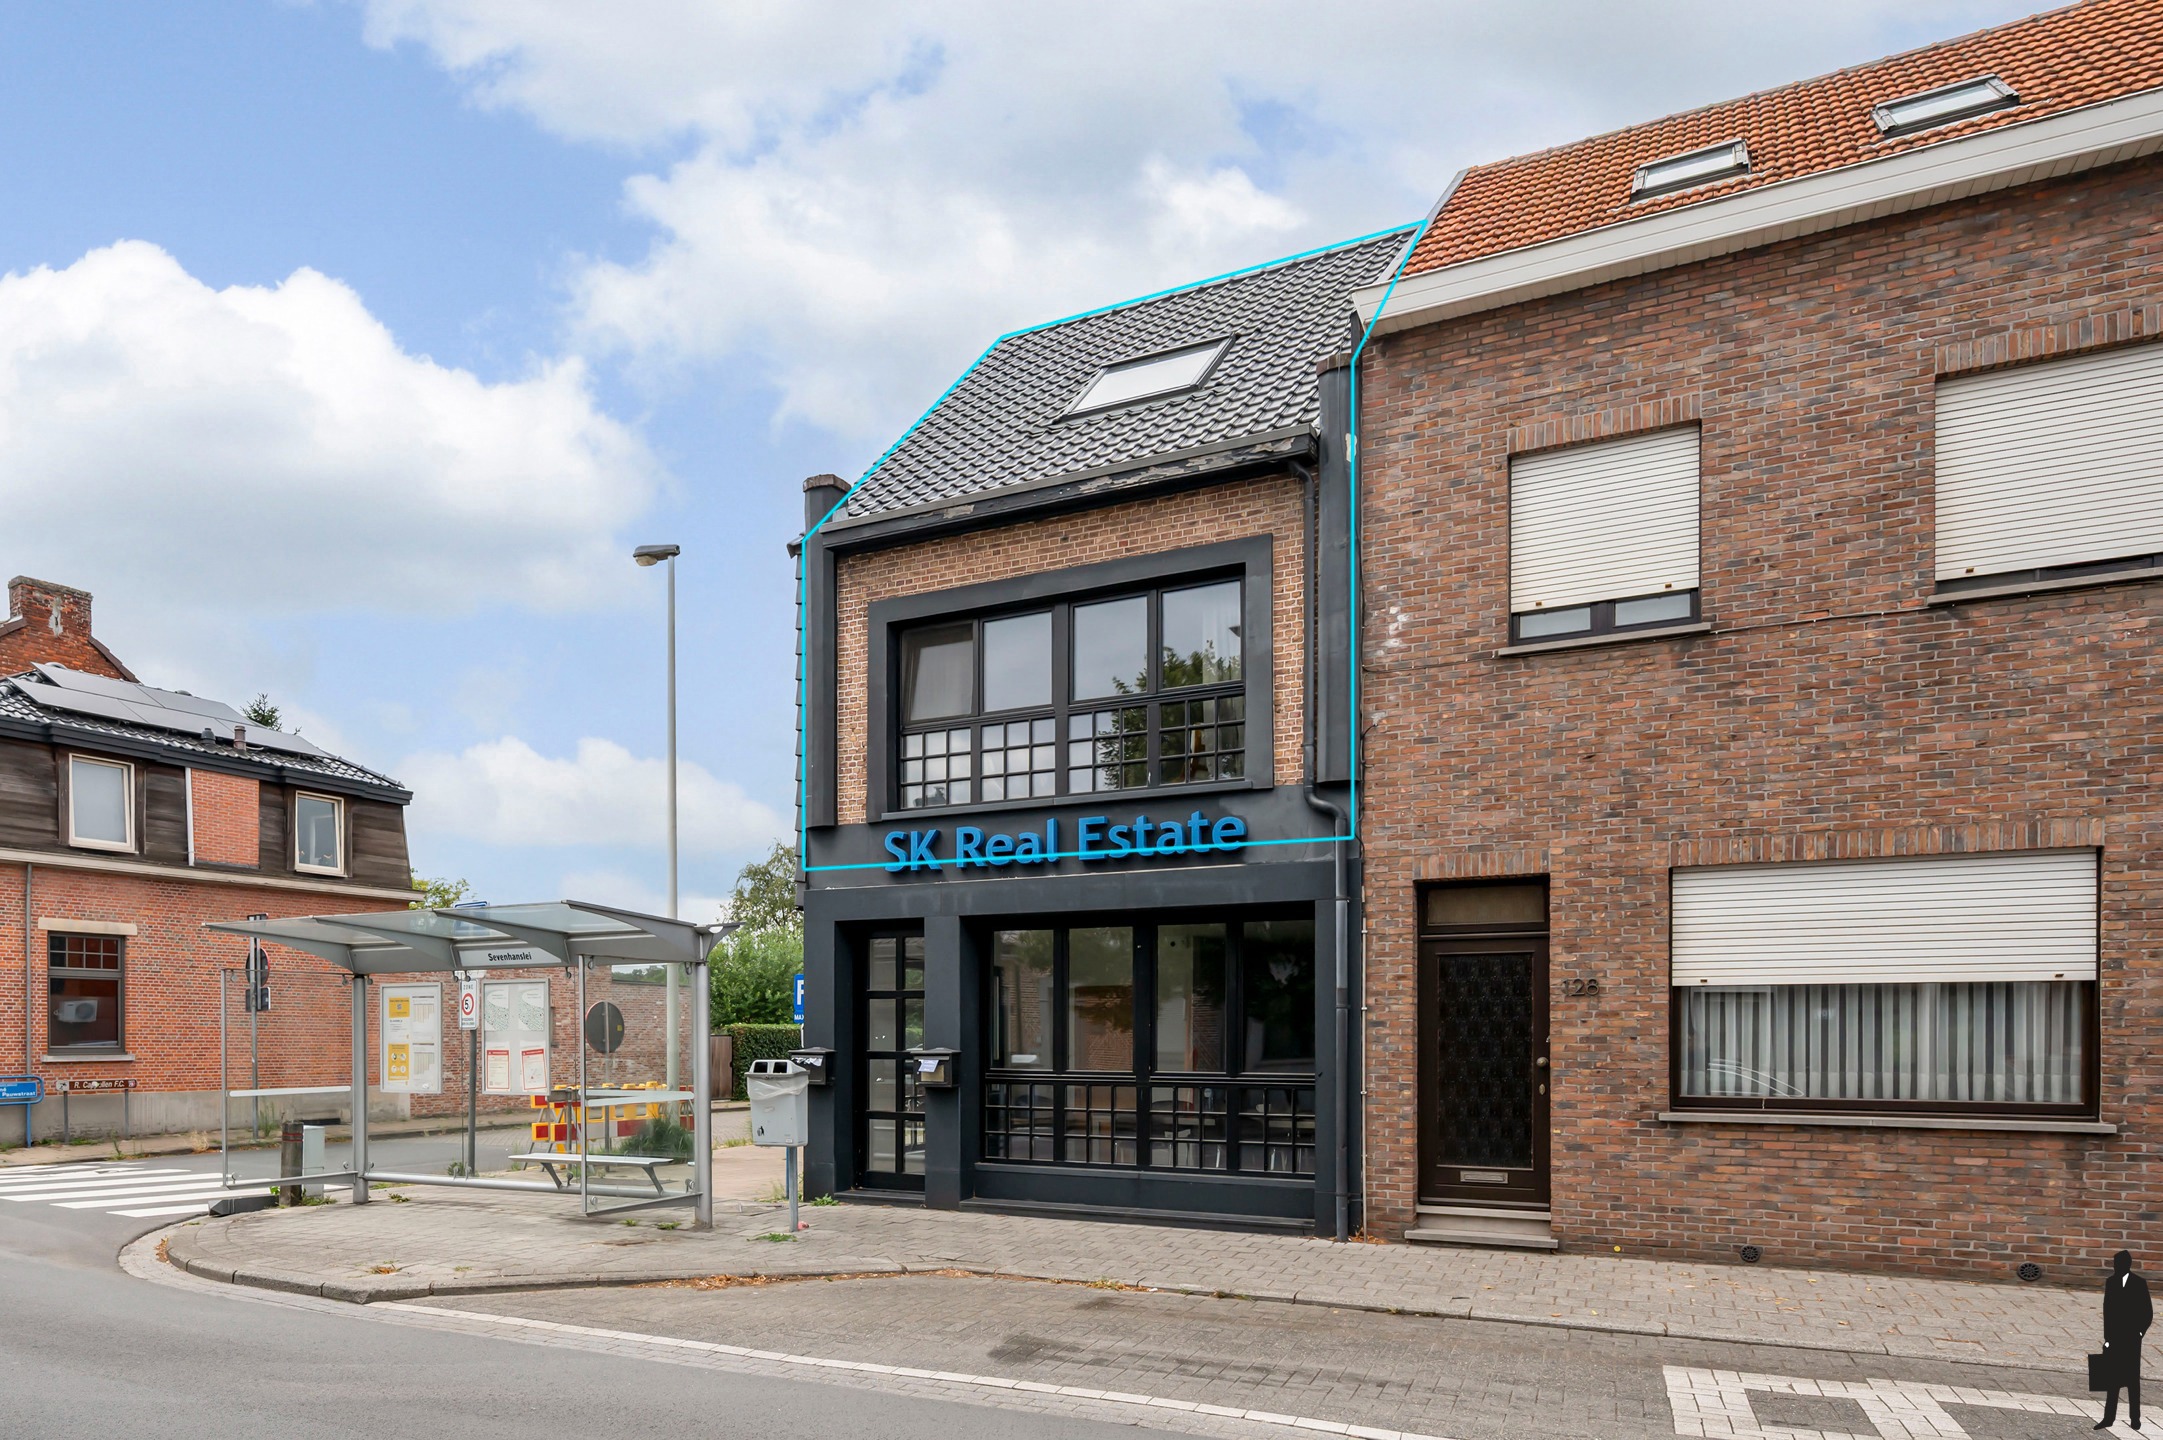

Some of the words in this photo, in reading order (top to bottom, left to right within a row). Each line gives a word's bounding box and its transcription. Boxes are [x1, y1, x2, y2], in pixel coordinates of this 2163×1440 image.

[884, 829, 943, 872] SK
[956, 818, 1060, 868] Real
[1078, 810, 1248, 861] Estate
[488, 952, 532, 962] Sevenhanslei
[1561, 978, 1600, 997] 128
